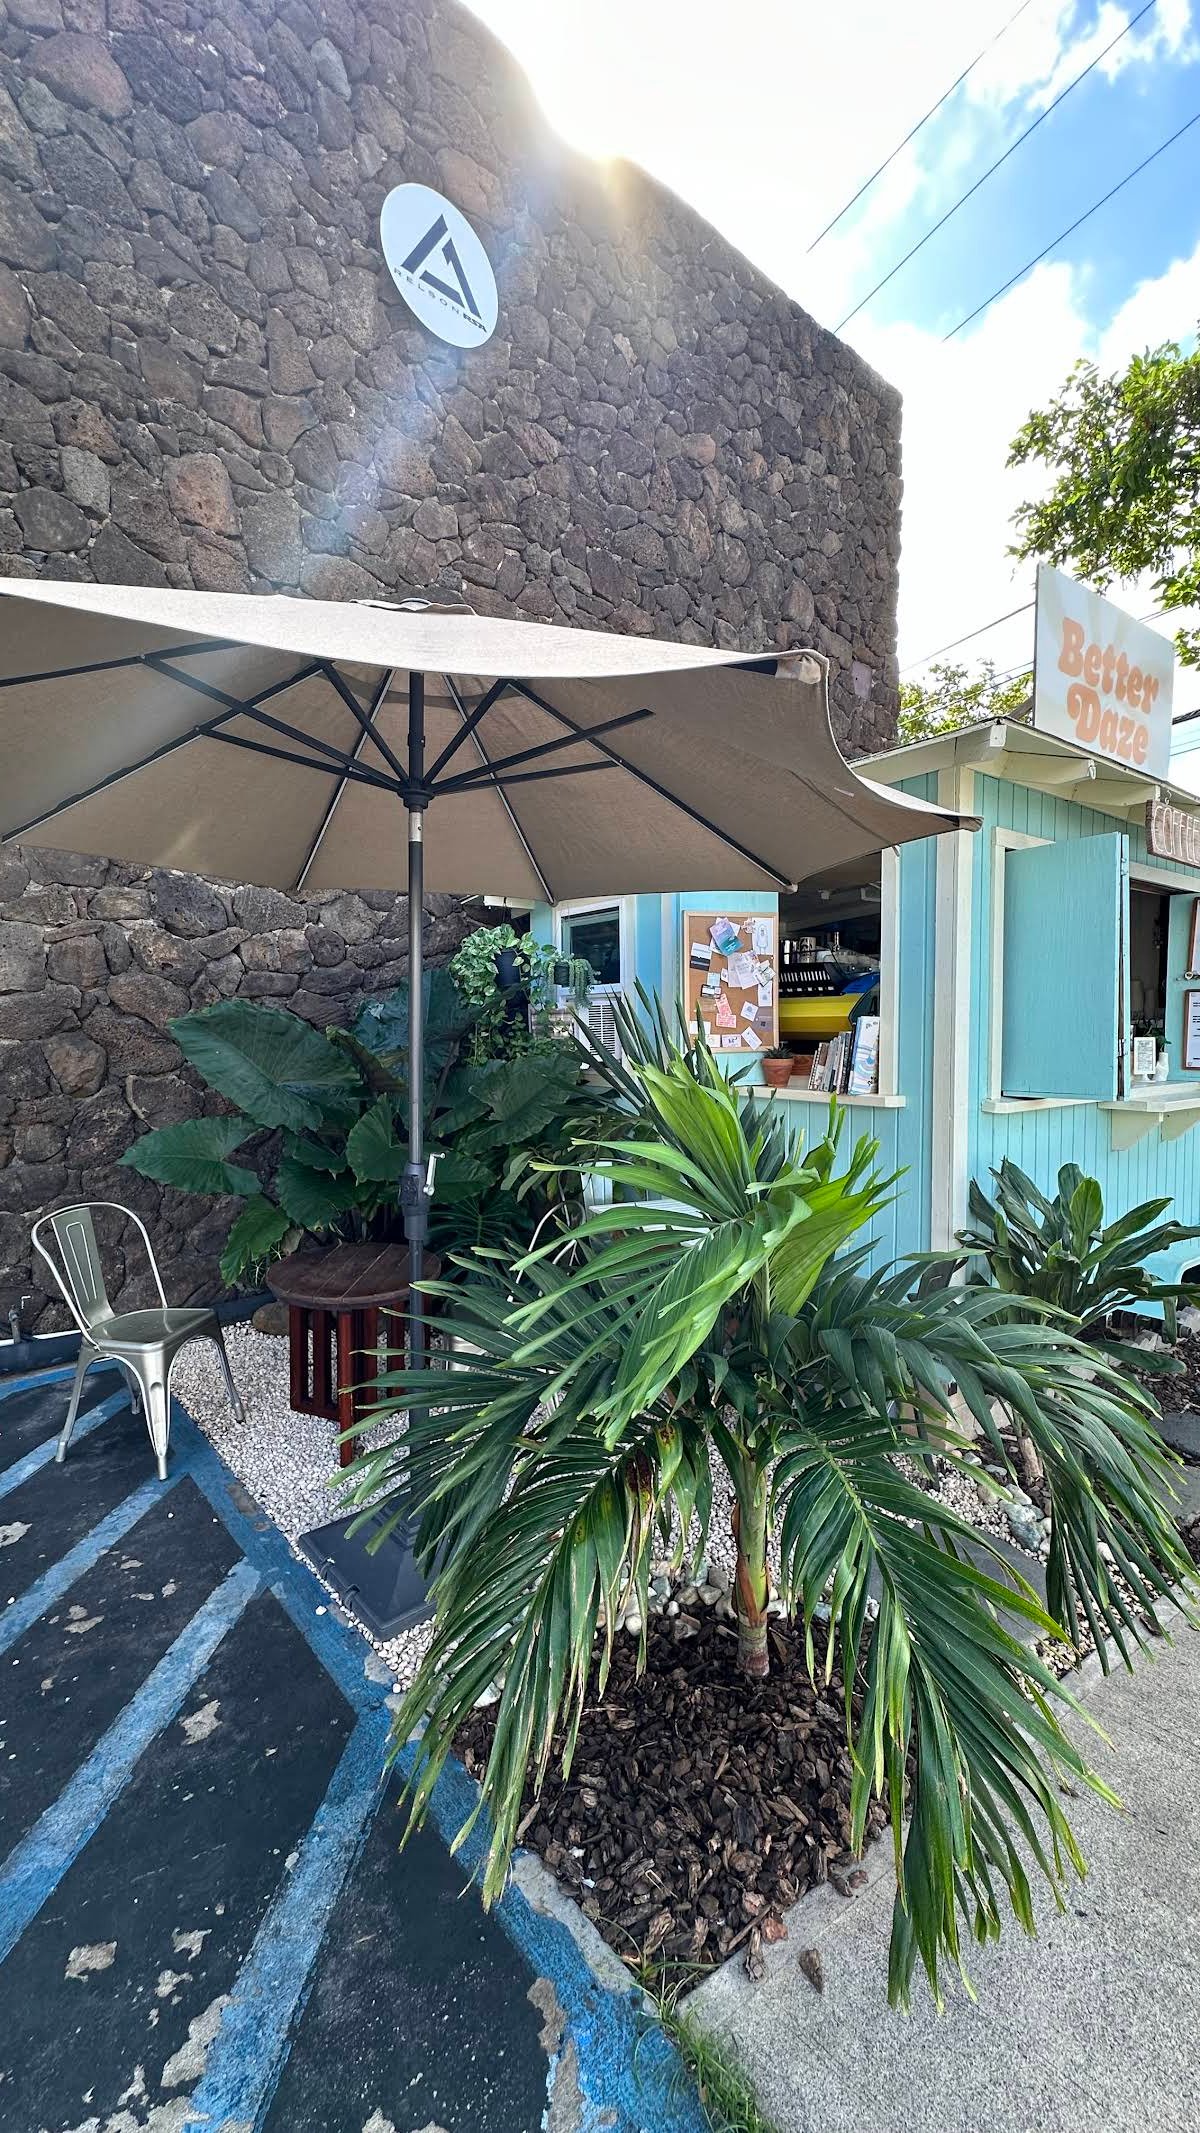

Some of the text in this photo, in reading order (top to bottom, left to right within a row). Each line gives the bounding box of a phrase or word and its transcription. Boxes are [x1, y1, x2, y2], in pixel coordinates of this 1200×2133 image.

[394, 267, 459, 314] RELSON
[1057, 617, 1159, 715] Better
[1067, 683, 1149, 766] Daze
[1154, 806, 1200, 863] COFFEE
